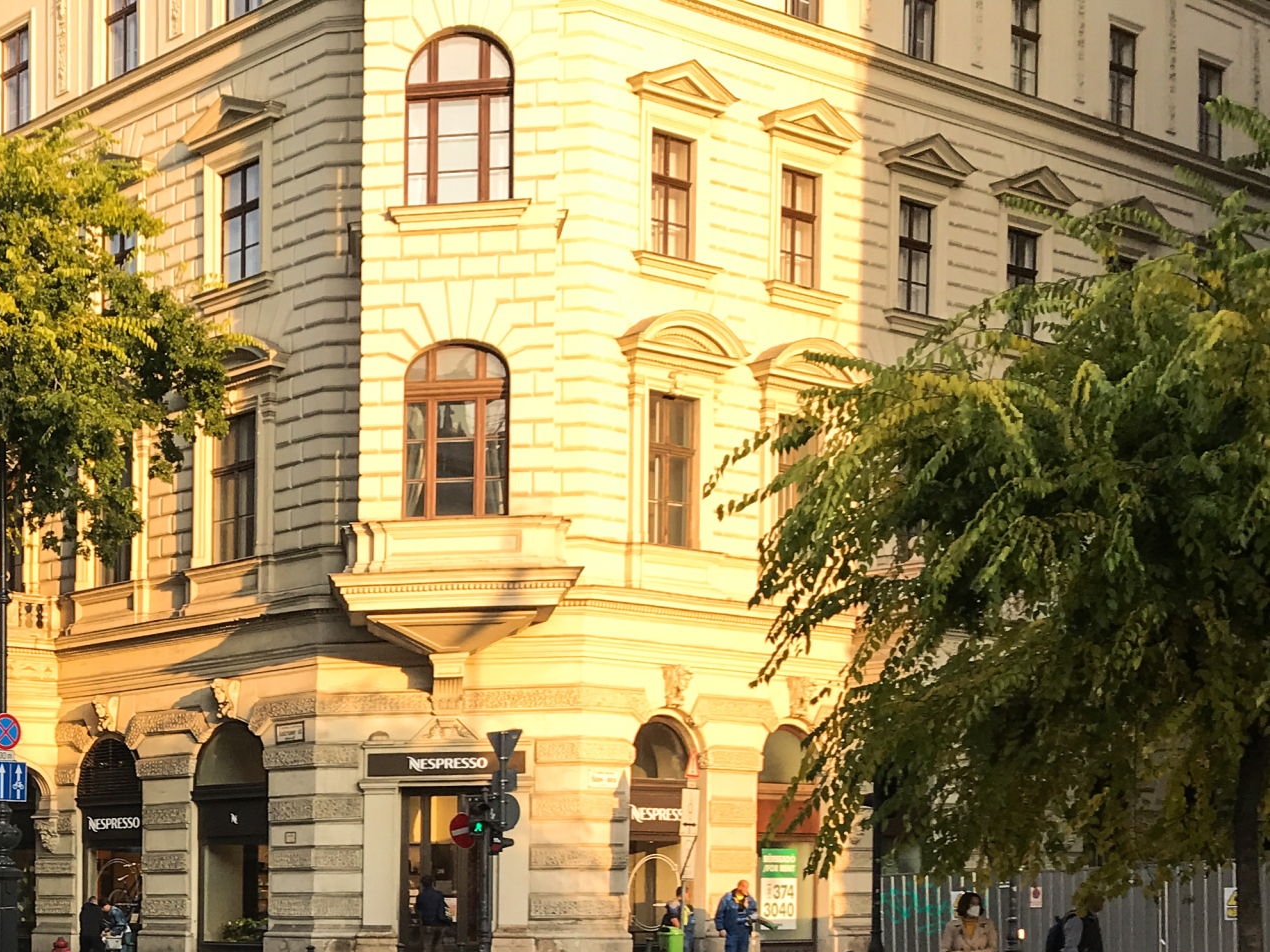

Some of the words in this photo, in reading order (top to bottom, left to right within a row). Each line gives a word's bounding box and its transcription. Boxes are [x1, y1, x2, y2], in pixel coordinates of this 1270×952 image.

[407, 756, 488, 772] NESPRESSO
[628, 804, 682, 823] NESPRESS
[87, 816, 140, 832] NESPRESSO
[773, 884, 795, 899] 374
[763, 902, 795, 917] 3040
